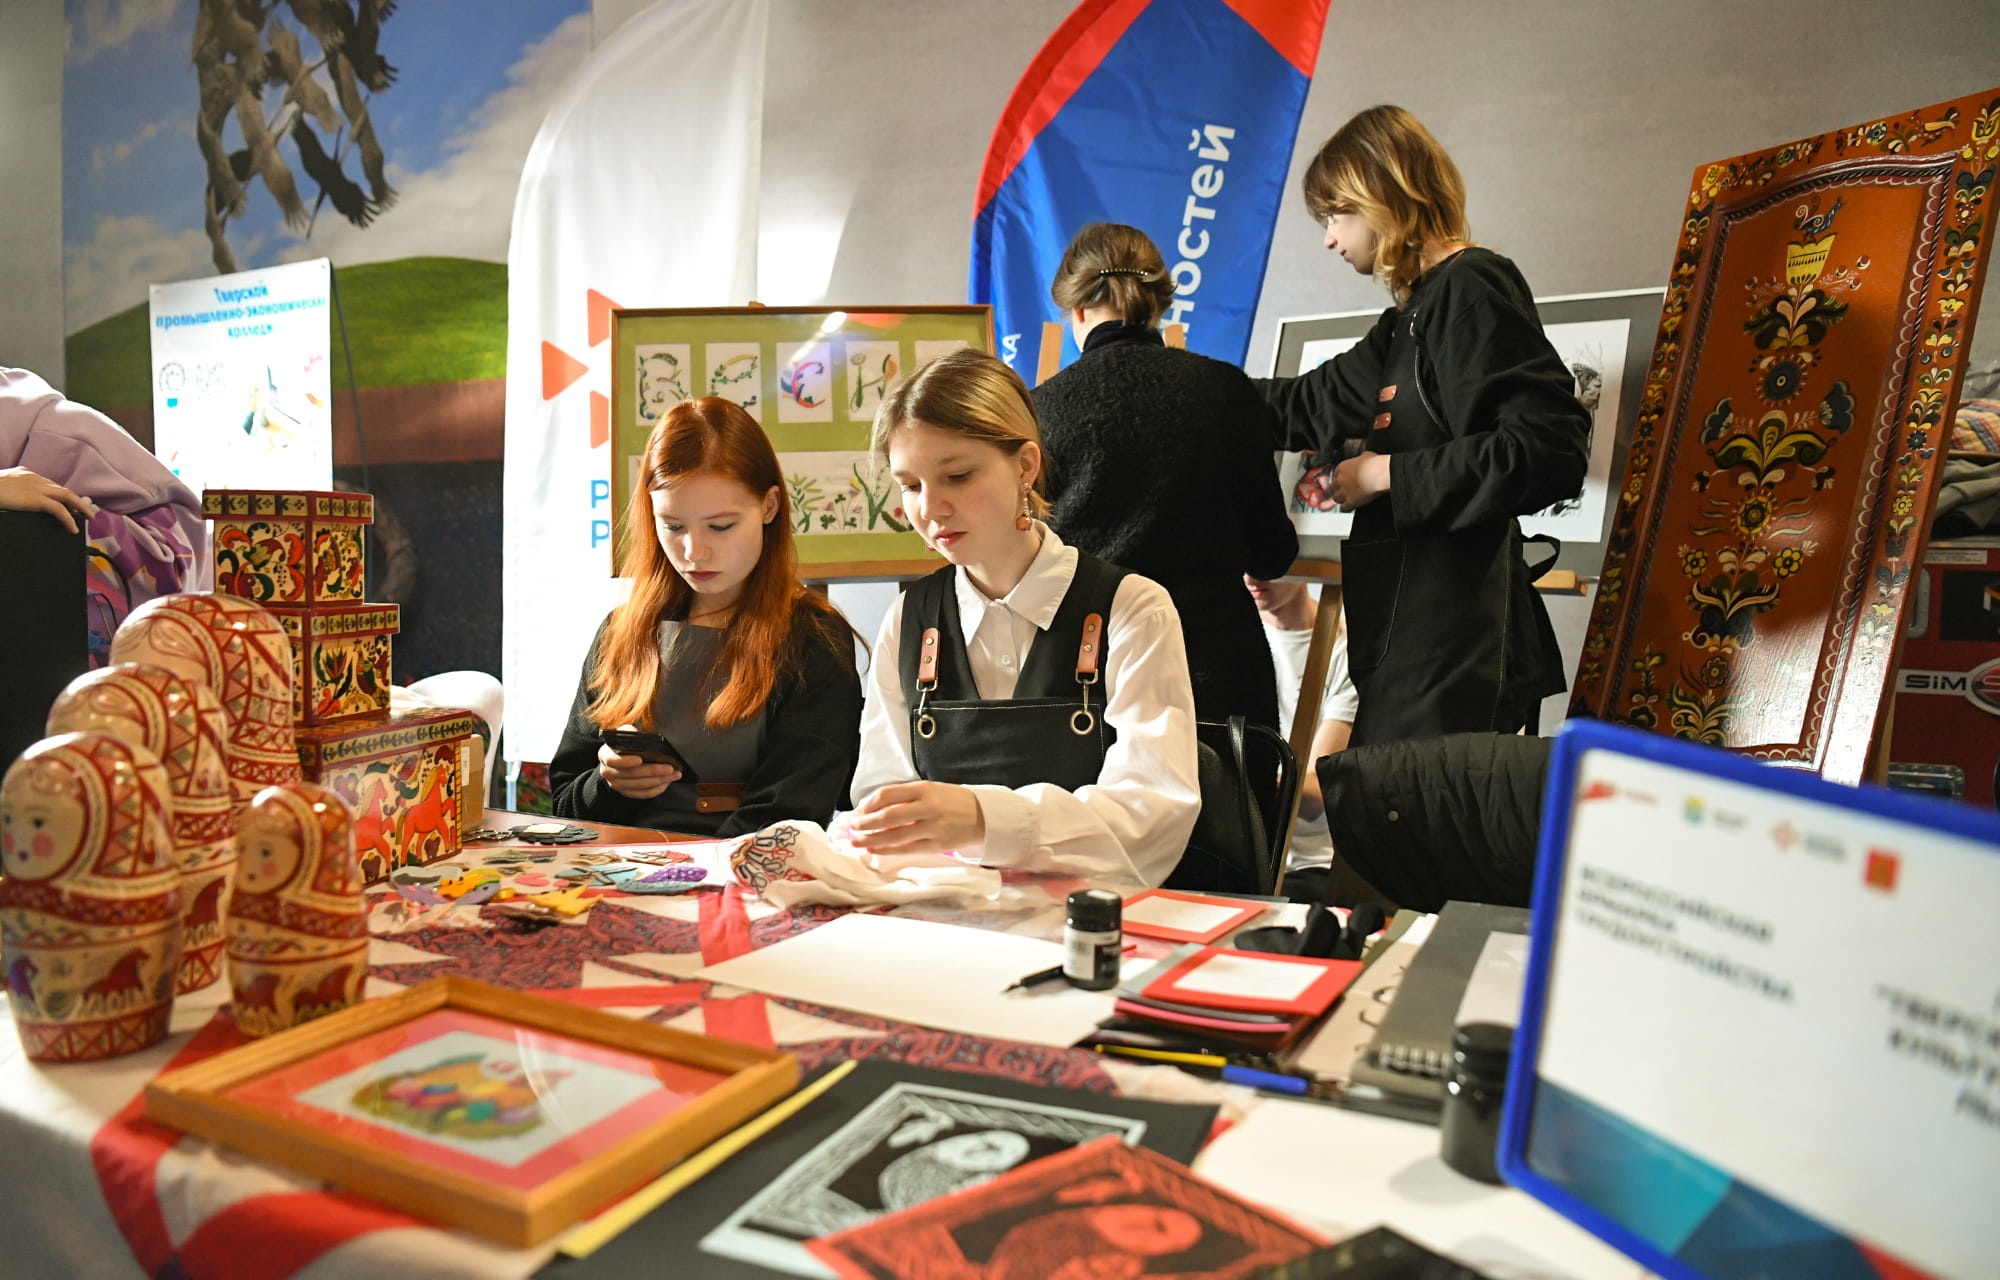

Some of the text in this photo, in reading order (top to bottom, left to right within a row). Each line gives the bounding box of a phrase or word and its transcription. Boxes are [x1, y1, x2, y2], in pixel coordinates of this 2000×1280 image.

[1158, 123, 1236, 335] ностей
[213, 281, 269, 303] Тверской
[591, 480, 609, 508] Р
[591, 520, 609, 548] Р
